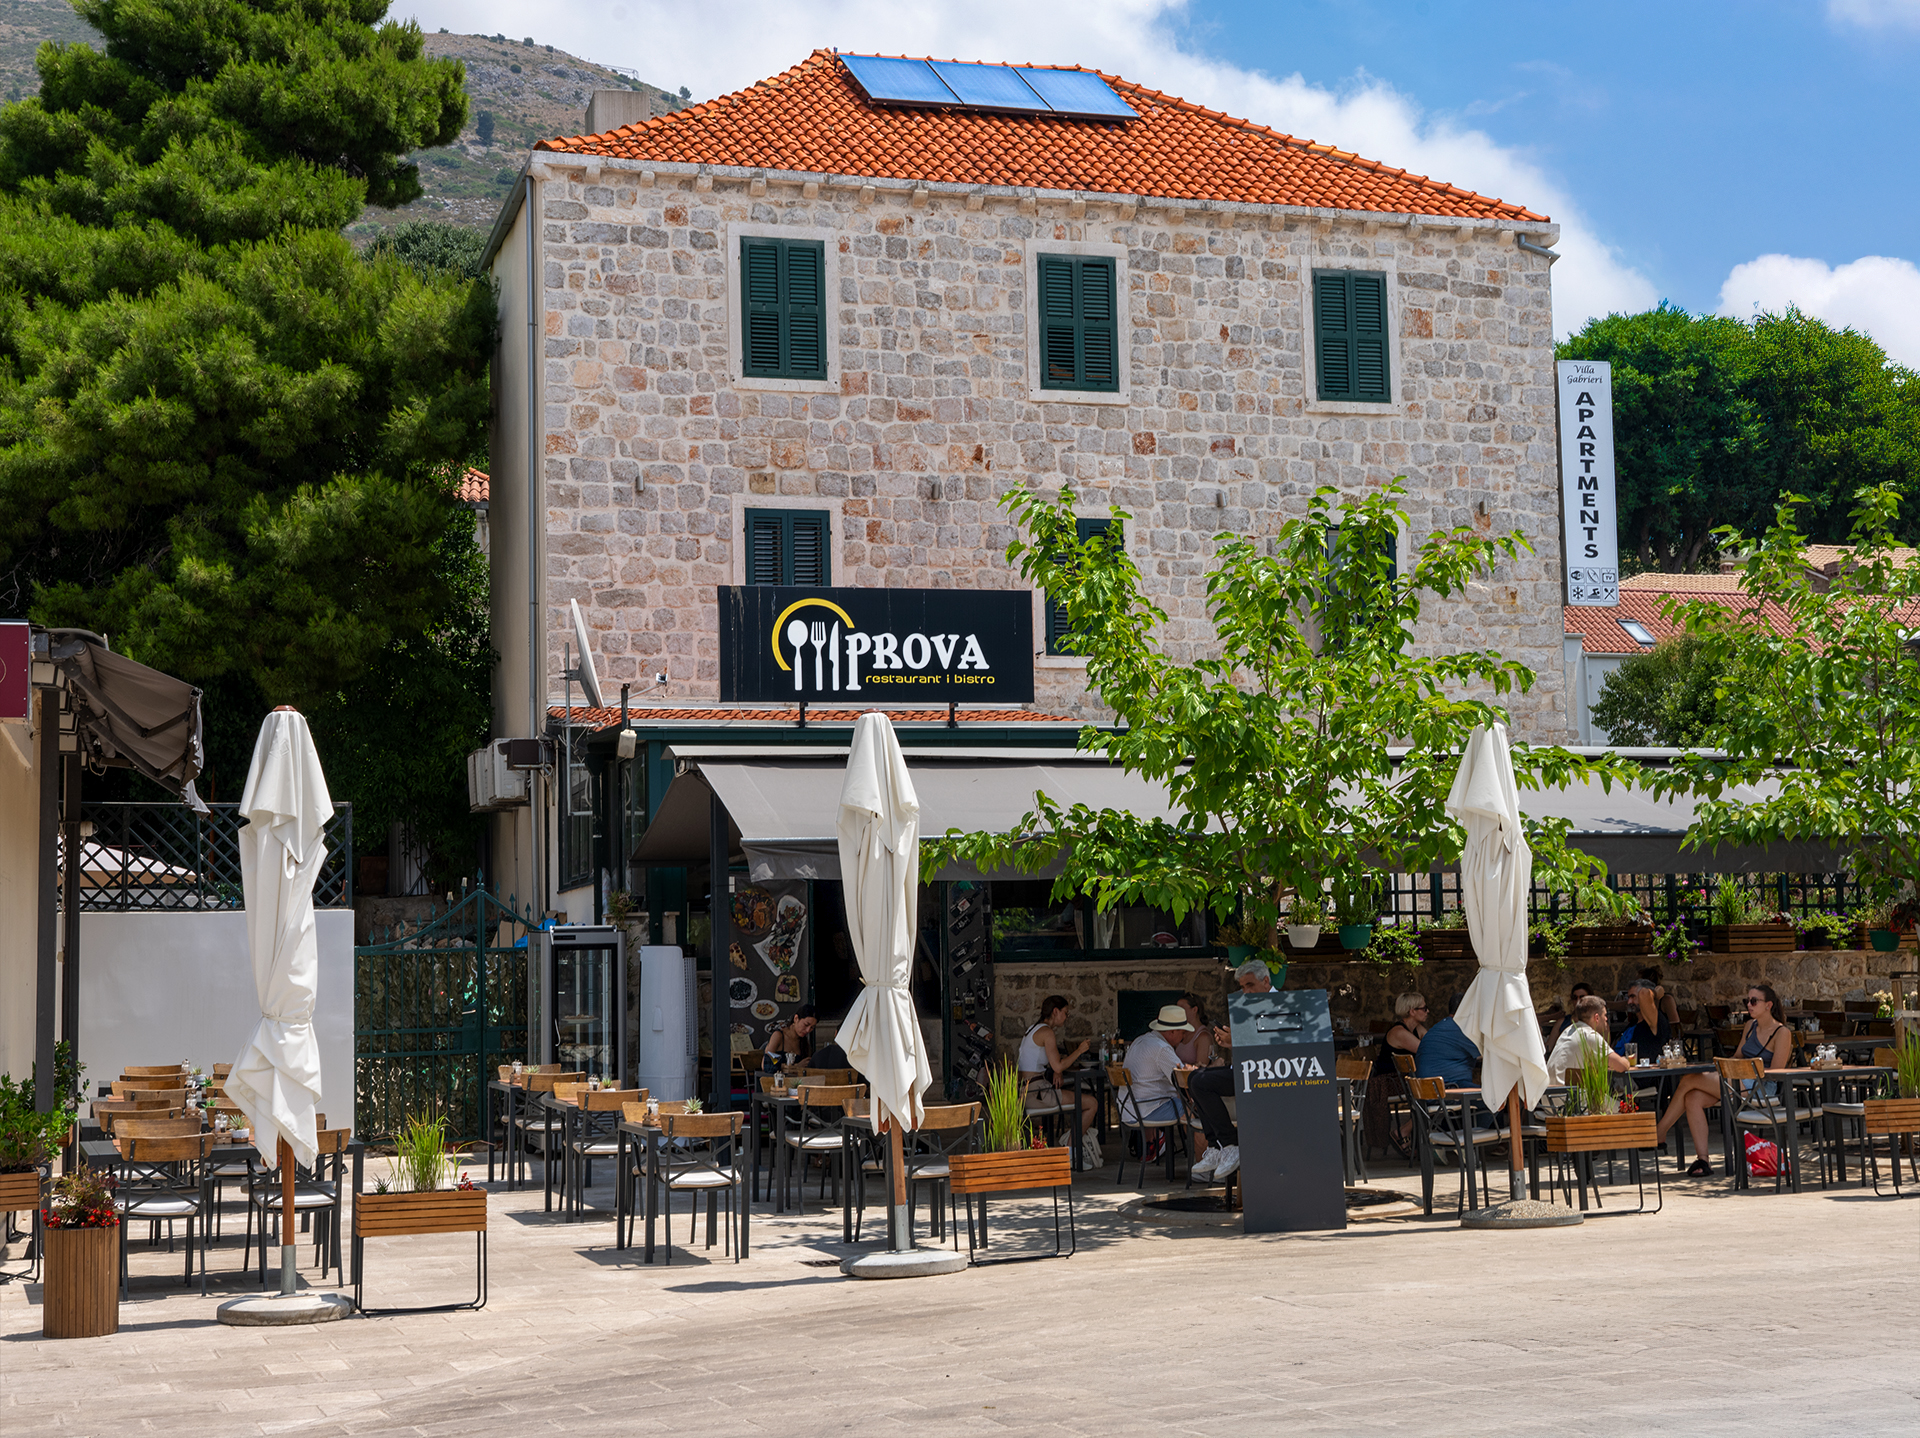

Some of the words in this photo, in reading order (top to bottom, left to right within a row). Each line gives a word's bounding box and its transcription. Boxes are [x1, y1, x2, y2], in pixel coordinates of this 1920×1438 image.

[1567, 374, 1603, 385] Gabrieri
[1573, 364, 1595, 374] Villa
[1575, 391, 1599, 559] APARTMENTS
[844, 632, 990, 691] PROVA
[865, 674, 941, 684] restaurant
[946, 674, 950, 683] i
[954, 674, 995, 685] bistro
[1241, 1056, 1325, 1093] PROVA
